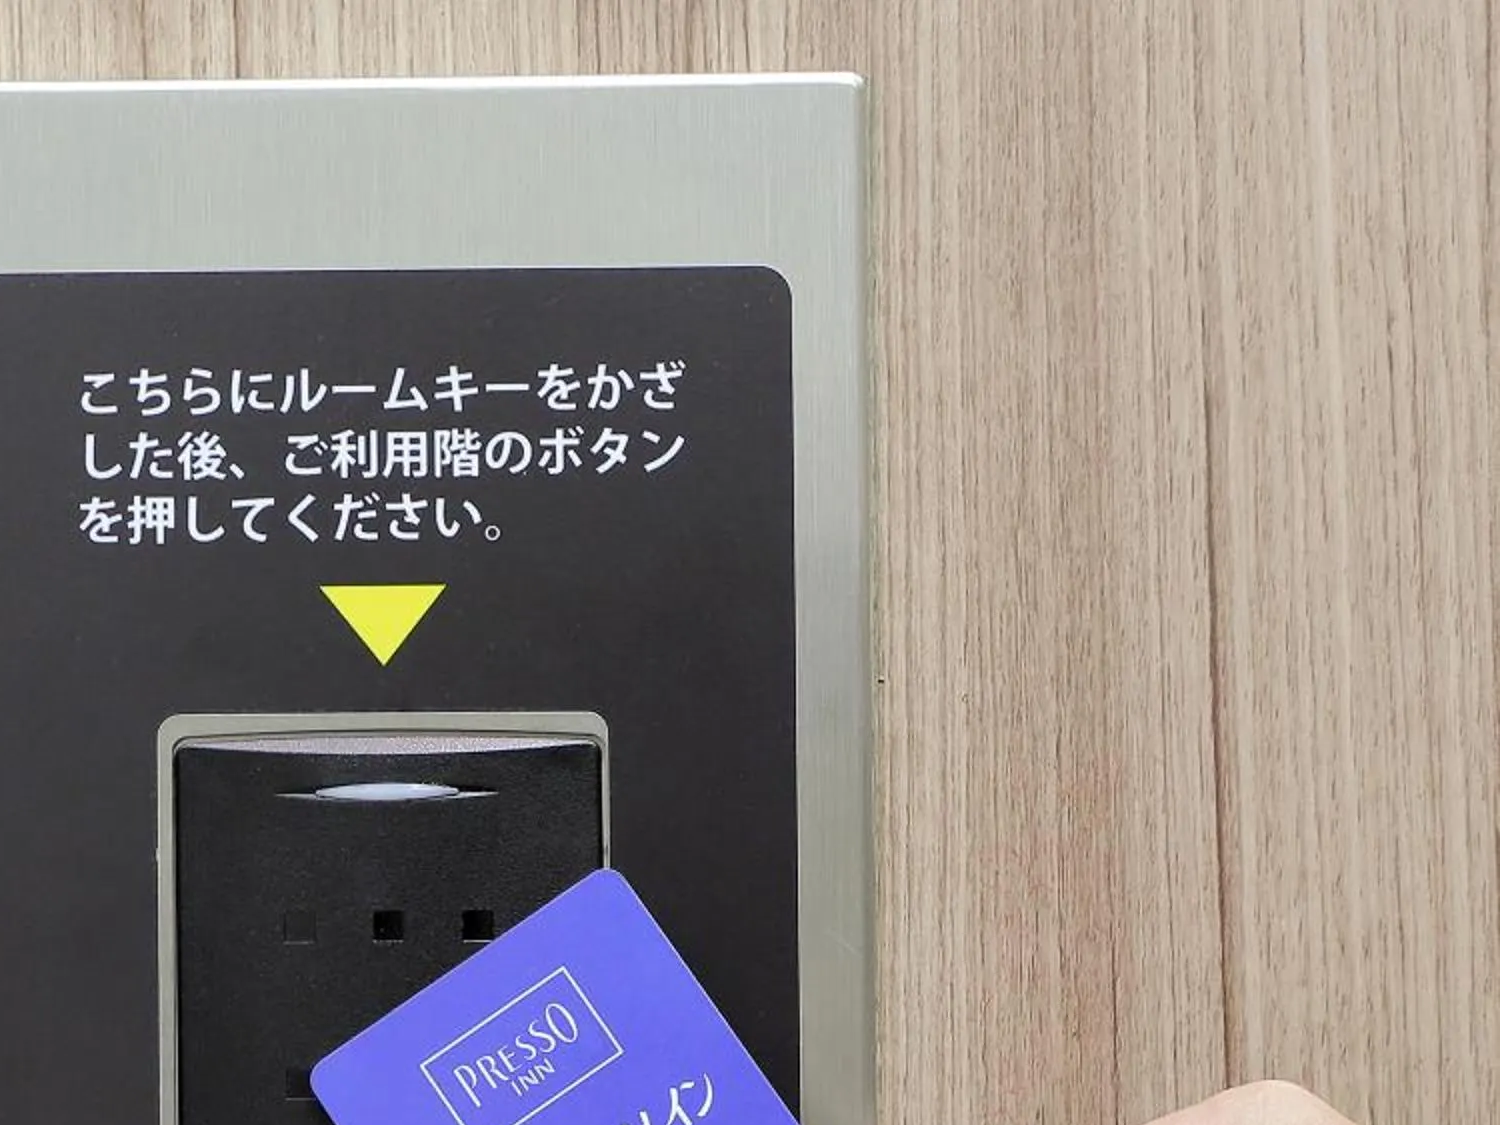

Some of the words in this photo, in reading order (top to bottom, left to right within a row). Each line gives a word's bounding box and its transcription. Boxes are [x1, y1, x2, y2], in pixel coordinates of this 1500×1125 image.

[80, 358, 686, 417] こちらにルームキーをかざ
[83, 428, 686, 481] した後、ご利用階のボタン
[78, 491, 503, 545] を押してください。
[452, 1002, 579, 1109] PRESSO
[510, 1057, 556, 1098] INN
